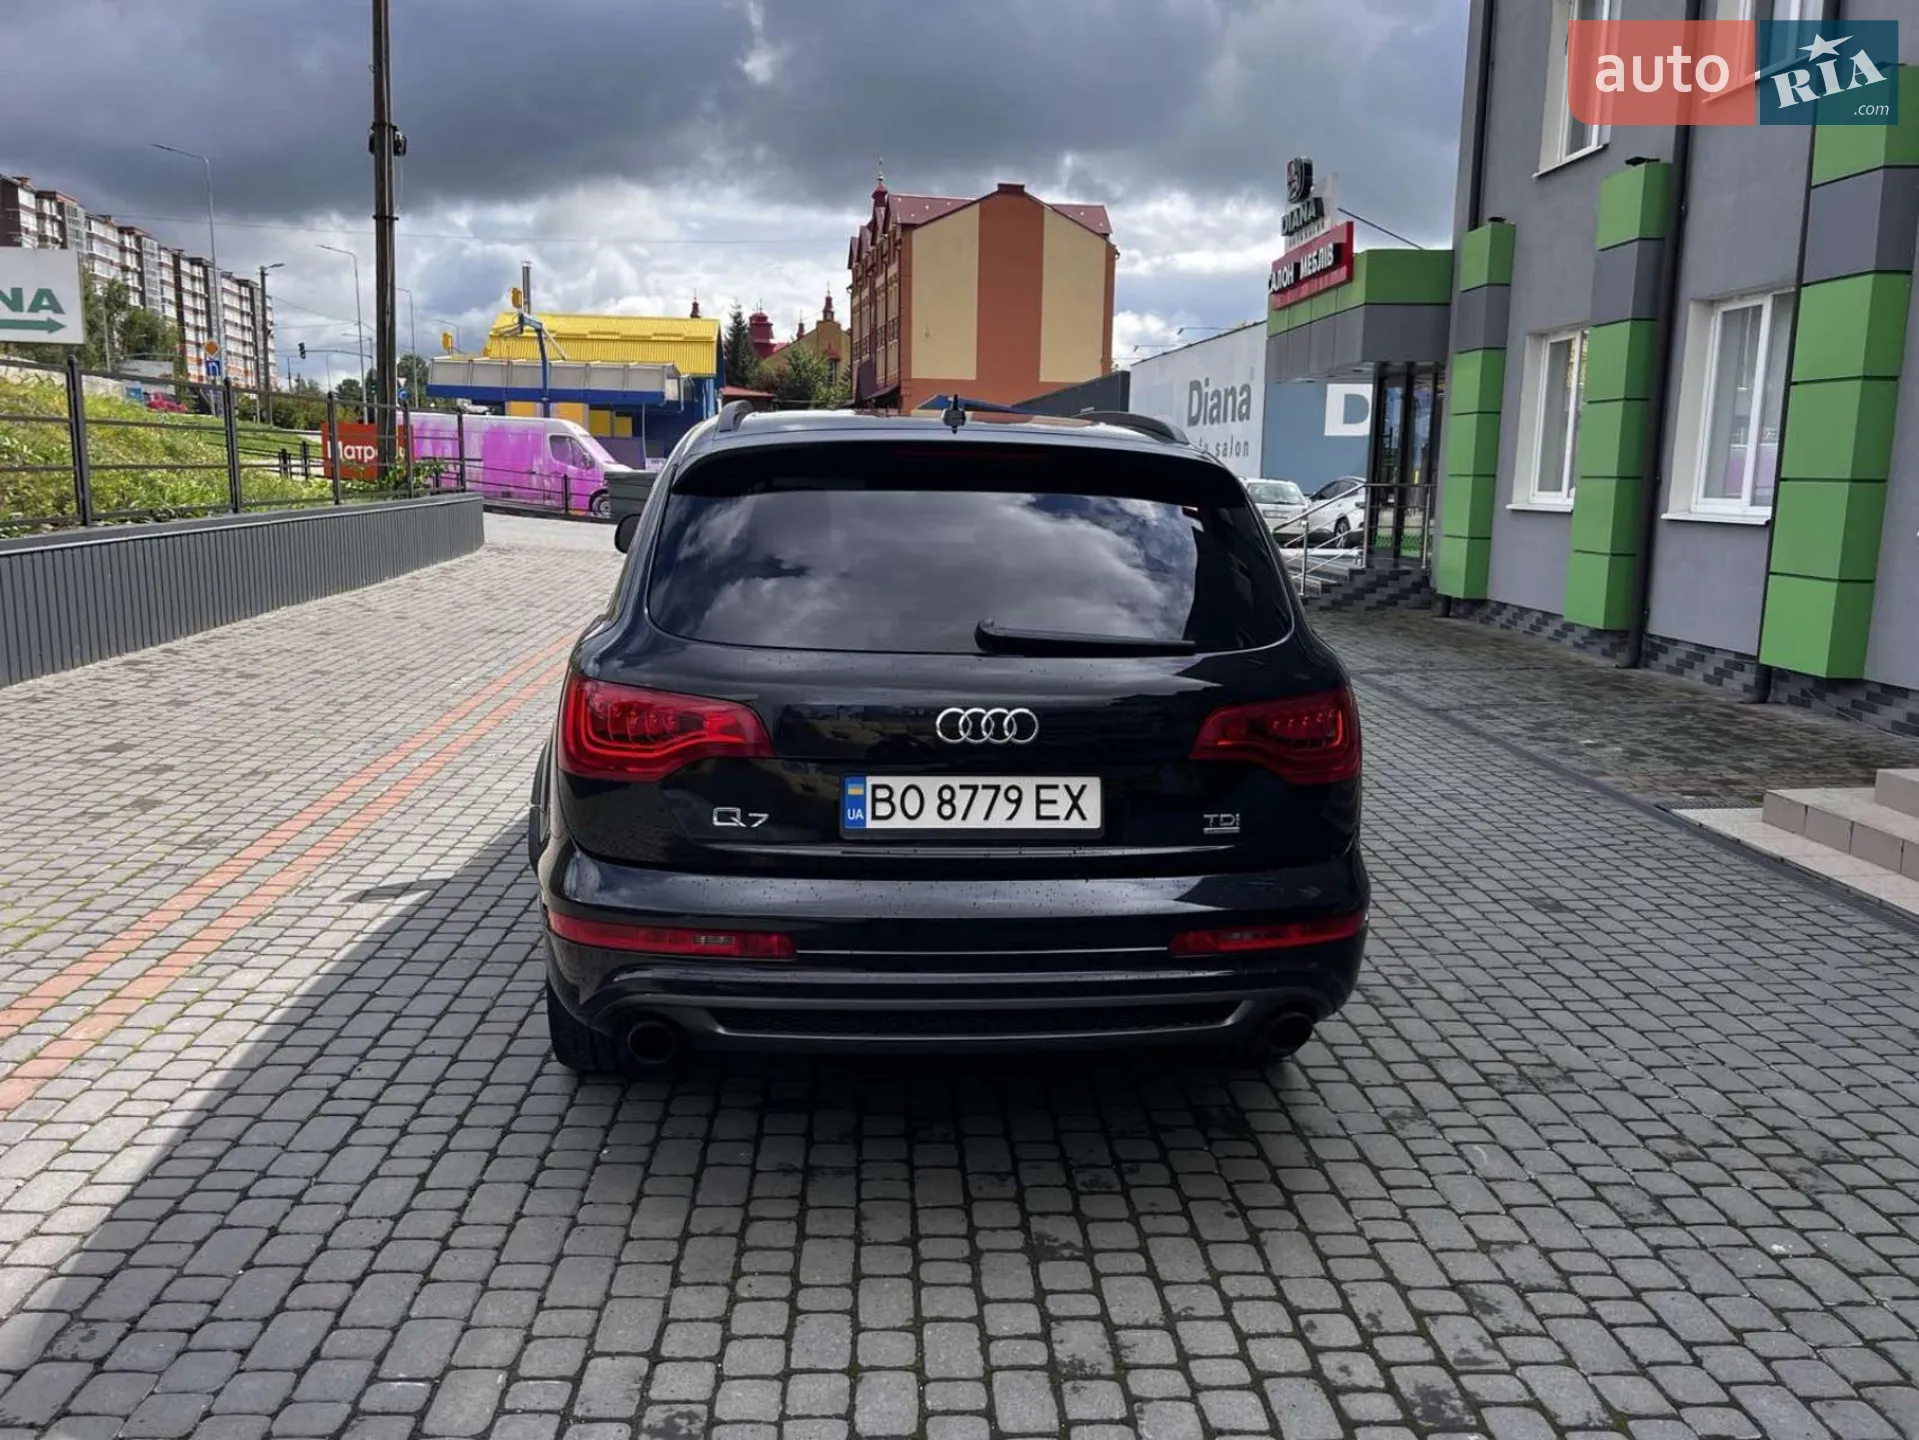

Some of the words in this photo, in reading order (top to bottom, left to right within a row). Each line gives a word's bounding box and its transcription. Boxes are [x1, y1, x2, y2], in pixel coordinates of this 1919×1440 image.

[1281, 199, 1320, 236] DIANA
[1300, 242, 1334, 281] МЕБЛІВ
[1187, 377, 1251, 427] Diana
[1215, 434, 1250, 458] salon
[847, 809, 864, 820] UA
[870, 784, 925, 821] BO
[936, 784, 1023, 821] 8779
[1035, 784, 1088, 821] EX
